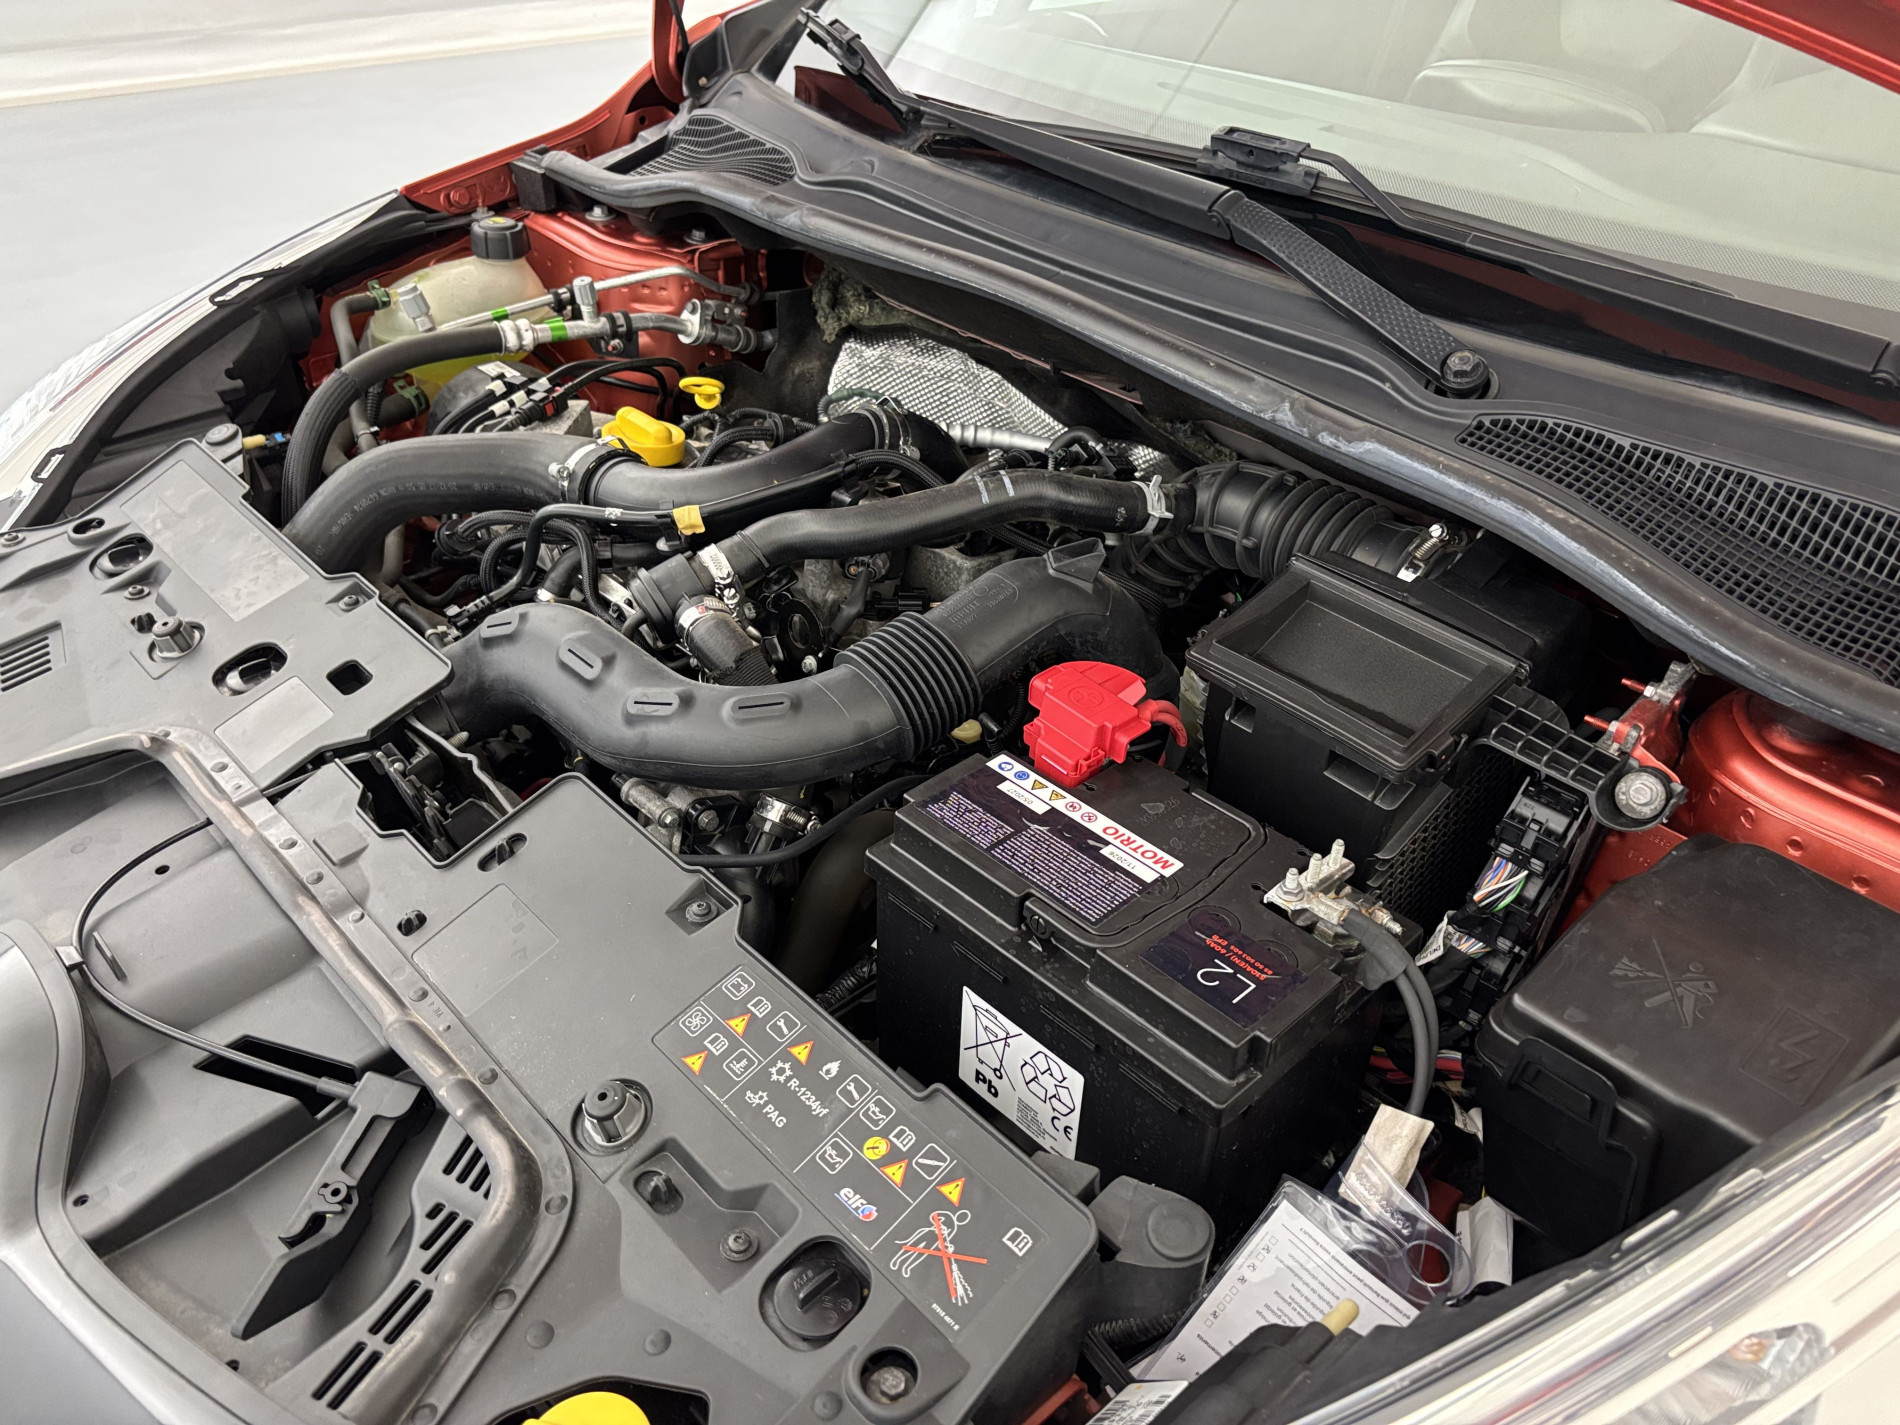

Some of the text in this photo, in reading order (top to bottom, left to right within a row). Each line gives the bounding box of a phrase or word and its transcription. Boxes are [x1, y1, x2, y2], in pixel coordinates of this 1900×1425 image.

[1006, 787, 1034, 806] 05/2027
[1102, 825, 1175, 870] MOTRIO
[1108, 850, 1136, 870] 11/2026
[1197, 959, 1256, 1004] L2
[974, 1068, 999, 1098] Pb
[787, 1078, 829, 1118] R-1234yf
[762, 1103, 787, 1128] PAG
[839, 1187, 867, 1210] elf
